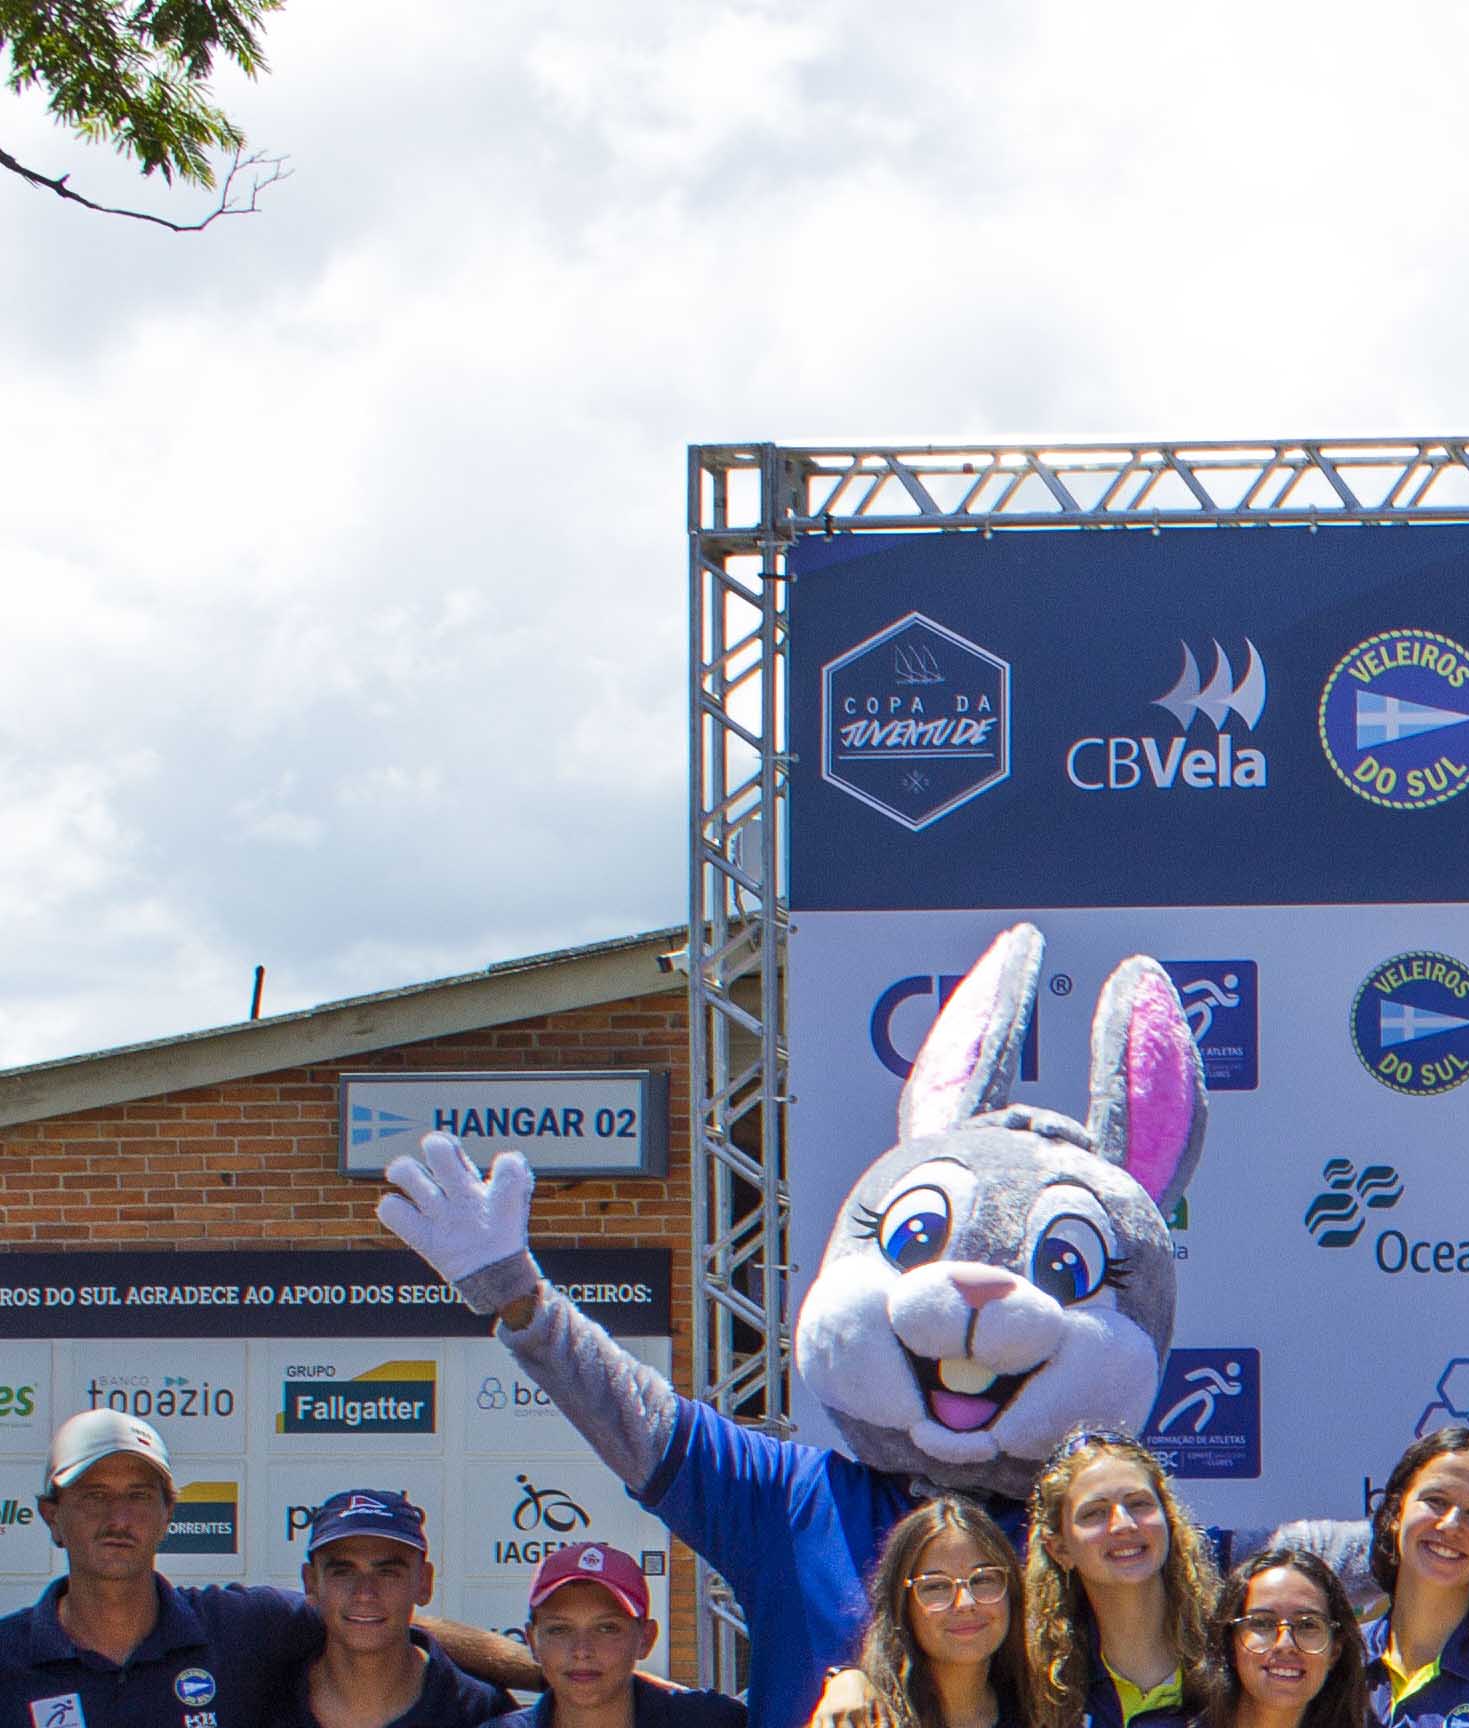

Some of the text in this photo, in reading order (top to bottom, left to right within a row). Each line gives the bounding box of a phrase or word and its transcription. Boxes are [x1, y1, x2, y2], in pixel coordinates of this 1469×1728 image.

[845, 695, 992, 714] COPA DA
[840, 717, 997, 747] JUVENTUDE
[1066, 734, 1268, 790] CBVela
[1353, 756, 1468, 797] DO SUL
[1377, 1051, 1413, 1083] DO
[434, 1107, 637, 1139] HANGAR 02
[45, 1287, 75, 1306] DO
[80, 1286, 121, 1305] SUL
[126, 1286, 239, 1305] AGRADECE
[244, 1286, 274, 1304] AO
[279, 1286, 346, 1304] APOIO
[350, 1286, 395, 1304] DOS
[99, 1376, 148, 1387] BANCO
[287, 1366, 335, 1378] GRUPO
[296, 1396, 423, 1423] Fallgatter
[1147, 1434, 1246, 1446] FORMAÇÃO DE ATLETAS
[169, 1522, 232, 1535] ORRENTES
